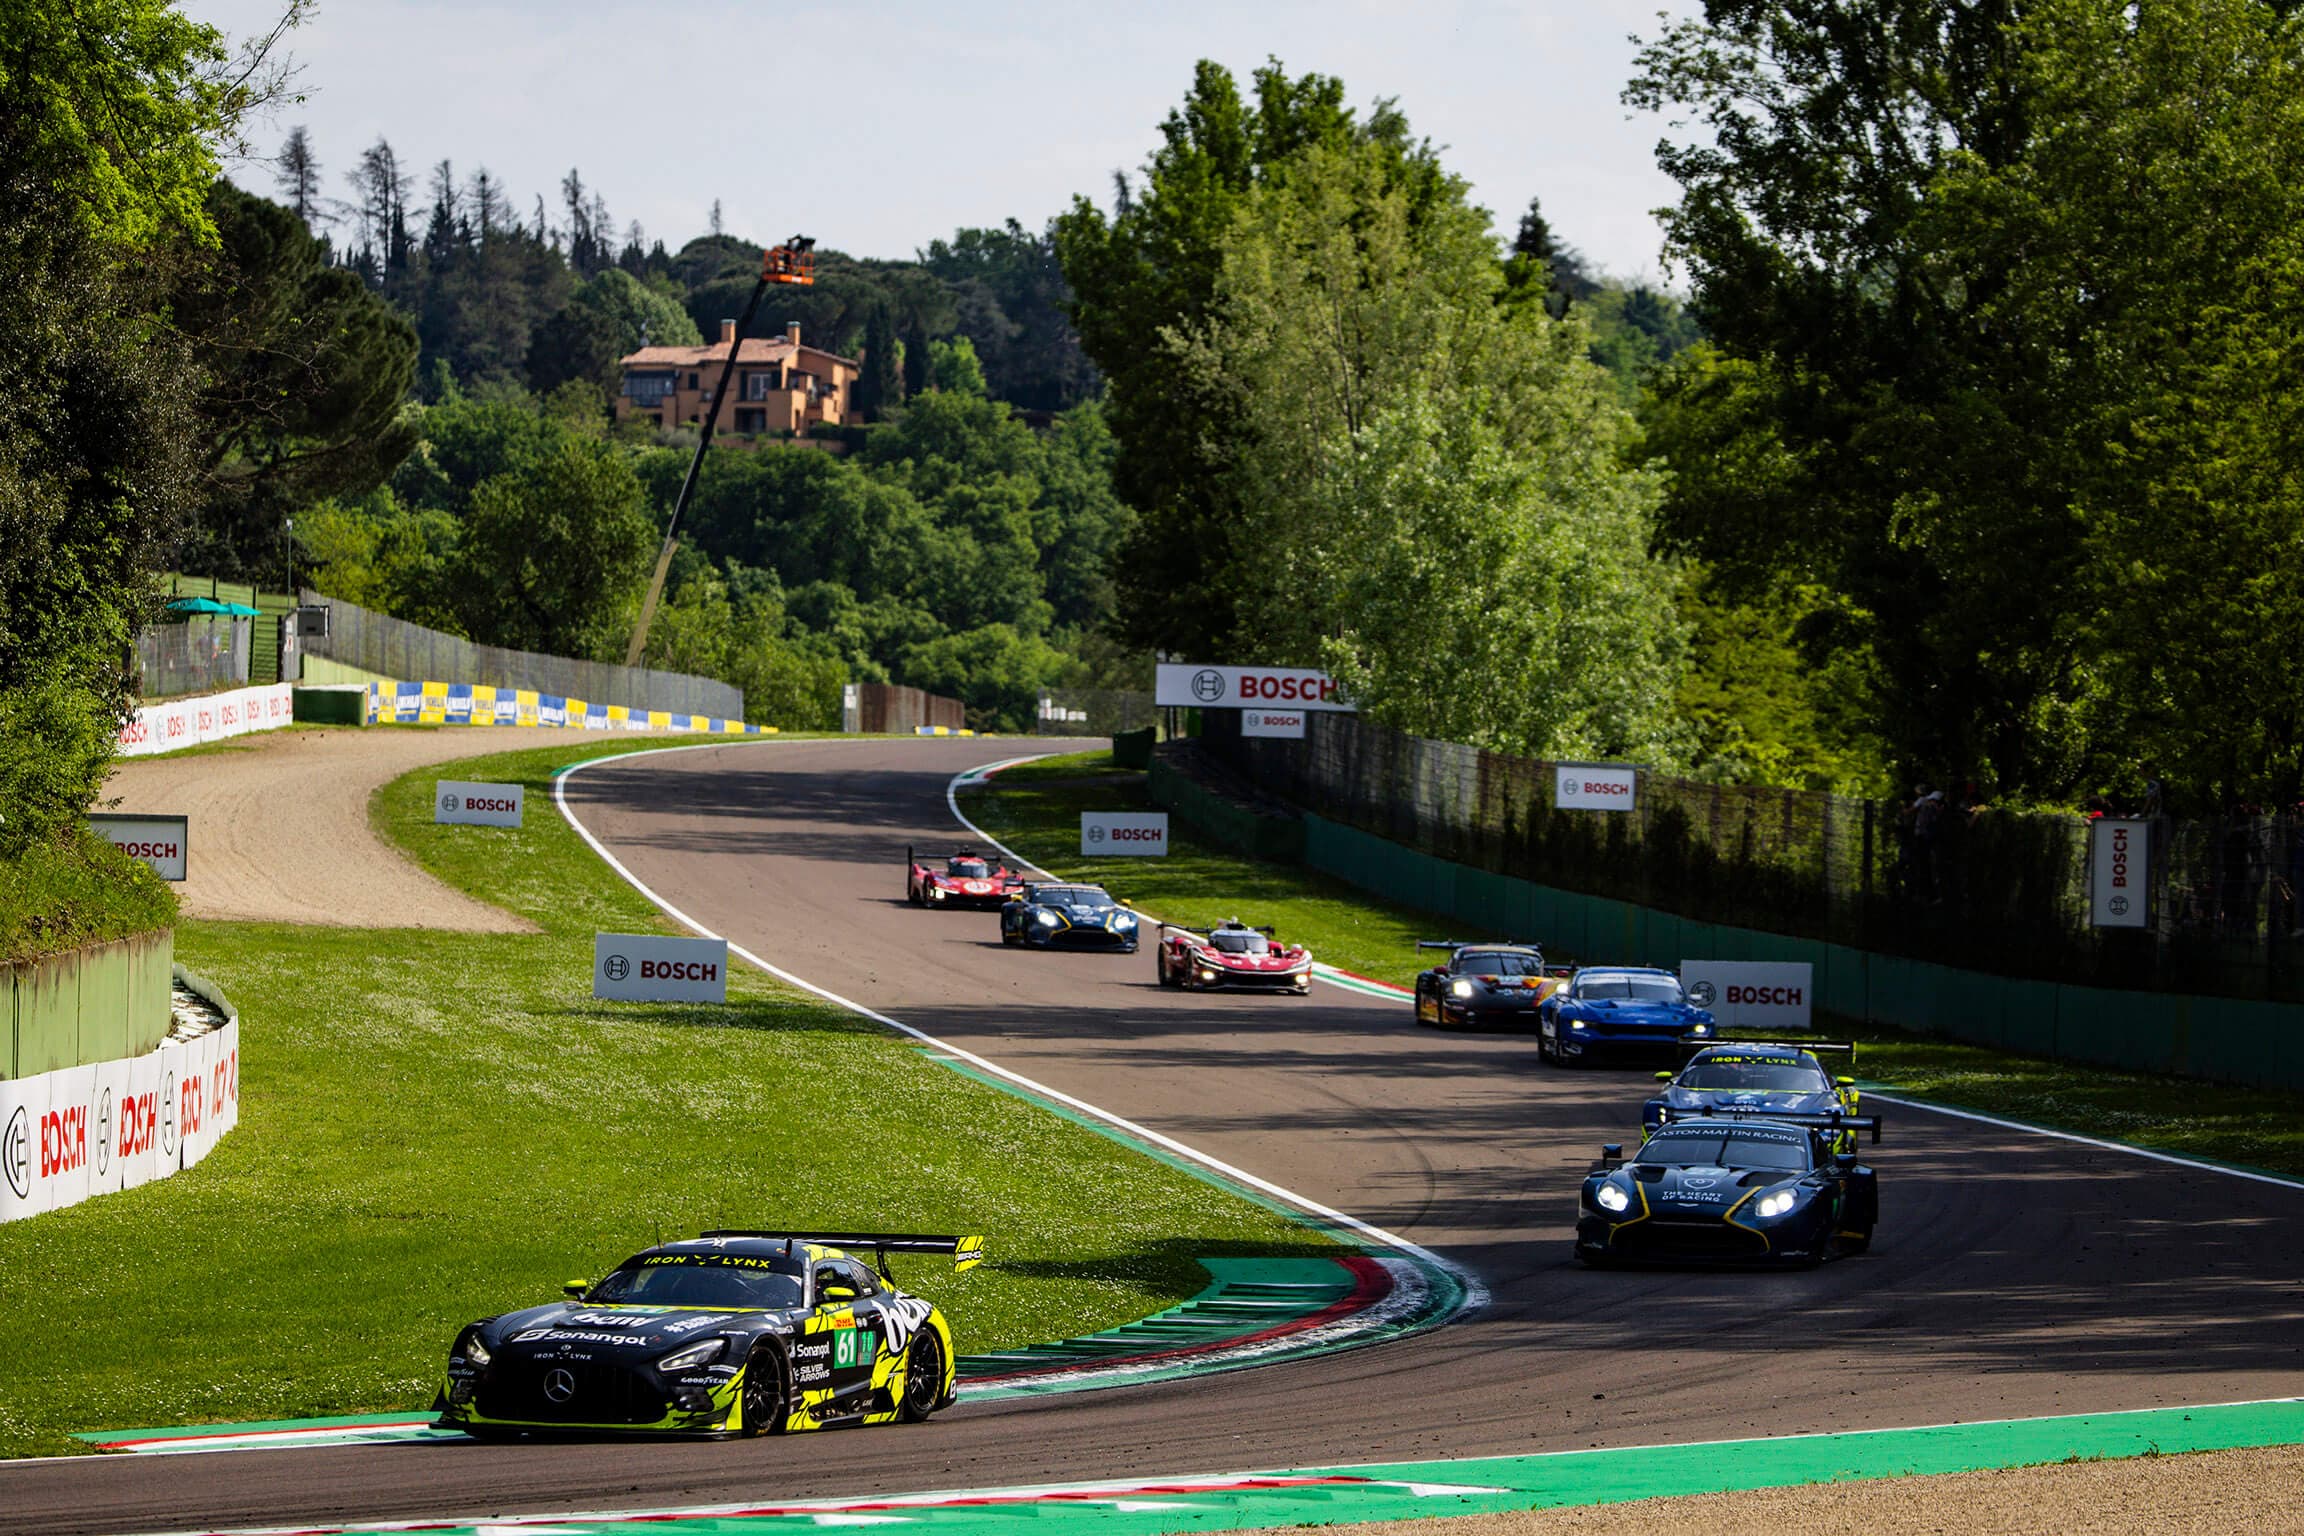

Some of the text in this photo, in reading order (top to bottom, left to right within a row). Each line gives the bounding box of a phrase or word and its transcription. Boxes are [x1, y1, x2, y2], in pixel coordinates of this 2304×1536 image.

[1240, 676, 1338, 700] BOSCH
[1263, 716, 1300, 726] BOSCH
[1584, 782, 1629, 795] BOSCH
[466, 798, 516, 812] BOSCH
[1111, 828, 1162, 841] BOSCH
[2112, 828, 2128, 888] BOSCH
[641, 960, 717, 982] BOSCH
[1726, 985, 1803, 1006] BOSCH
[1711, 1055, 1798, 1066] IRON LYNX
[41, 1105, 87, 1179] BOSCH
[1658, 1128, 1701, 1138] ASTON
[1753, 1132, 1801, 1144] RACING
[644, 1255, 771, 1269] IRON LYNX
[548, 1328, 648, 1346] Sonangol
[796, 1340, 831, 1360] Sonangol
[838, 1331, 855, 1364] 61
[800, 1363, 824, 1374] SILVER
[800, 1369, 831, 1383] ARROWS
